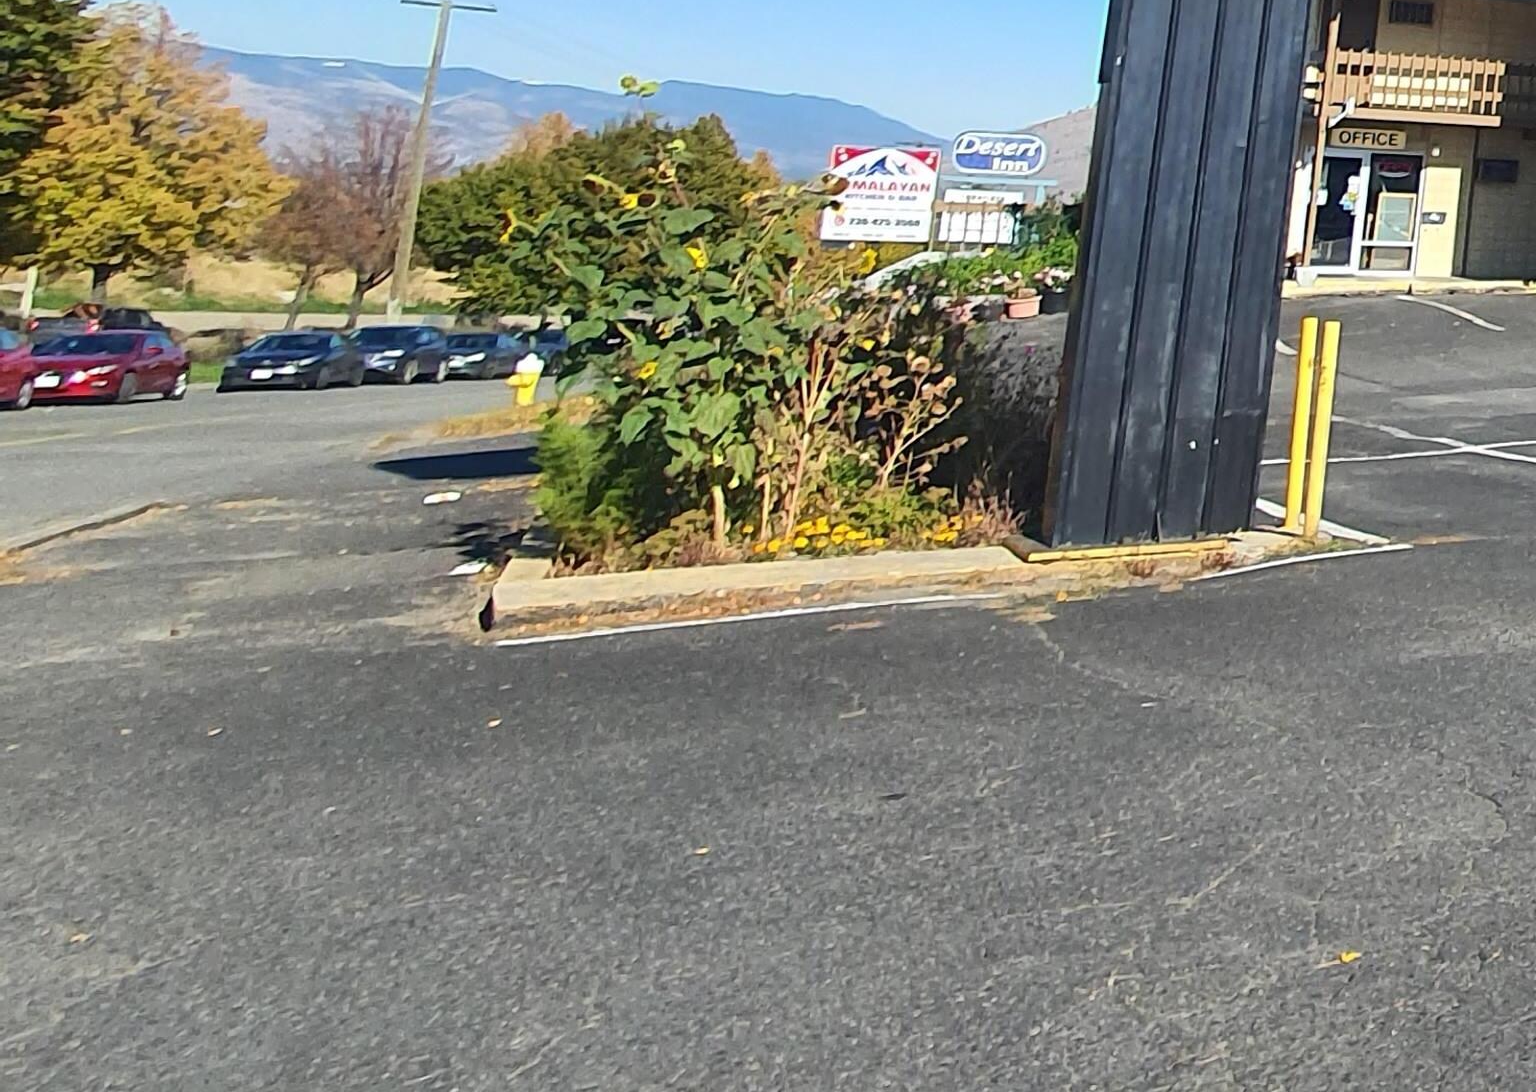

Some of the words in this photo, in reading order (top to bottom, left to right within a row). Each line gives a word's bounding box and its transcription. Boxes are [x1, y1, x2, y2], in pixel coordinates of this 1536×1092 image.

[956, 136, 1041, 157] Desert
[1338, 130, 1399, 147] OFFICE
[992, 156, 1029, 171] Inn
[848, 180, 931, 193] MALAYAN
